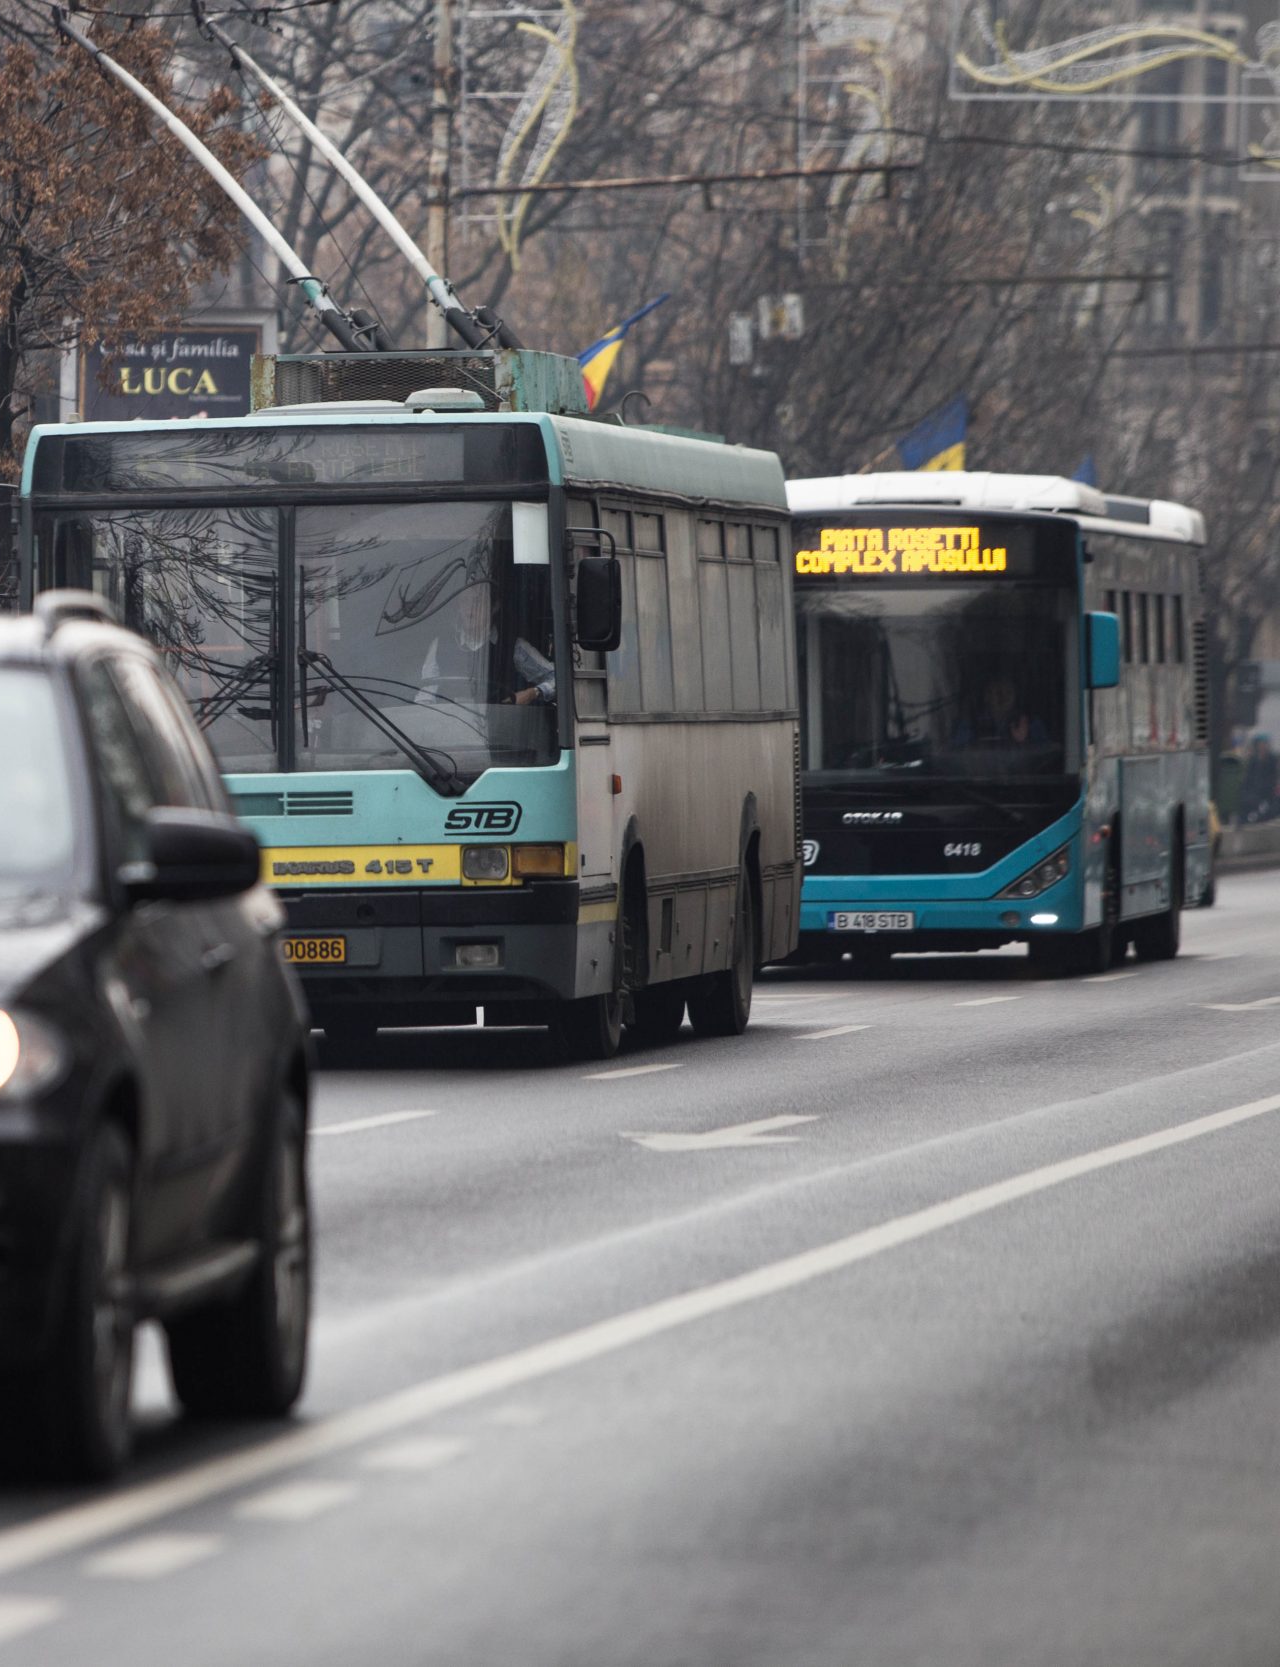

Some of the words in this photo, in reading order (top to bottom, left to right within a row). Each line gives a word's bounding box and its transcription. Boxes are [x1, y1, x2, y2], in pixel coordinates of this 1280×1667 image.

[166, 336, 240, 363] familia
[119, 367, 218, 395] LUCA
[820, 528, 883, 551] PIATA
[888, 527, 980, 550] ROSETTI
[795, 550, 897, 573] COMPLEX
[901, 548, 1007, 572] APUSULUI
[444, 806, 516, 831] STB
[842, 811, 903, 825] OTOKAR
[943, 842, 981, 857] 6418
[837, 914, 849, 929] B
[852, 914, 877, 928] 418
[879, 914, 909, 928] STB
